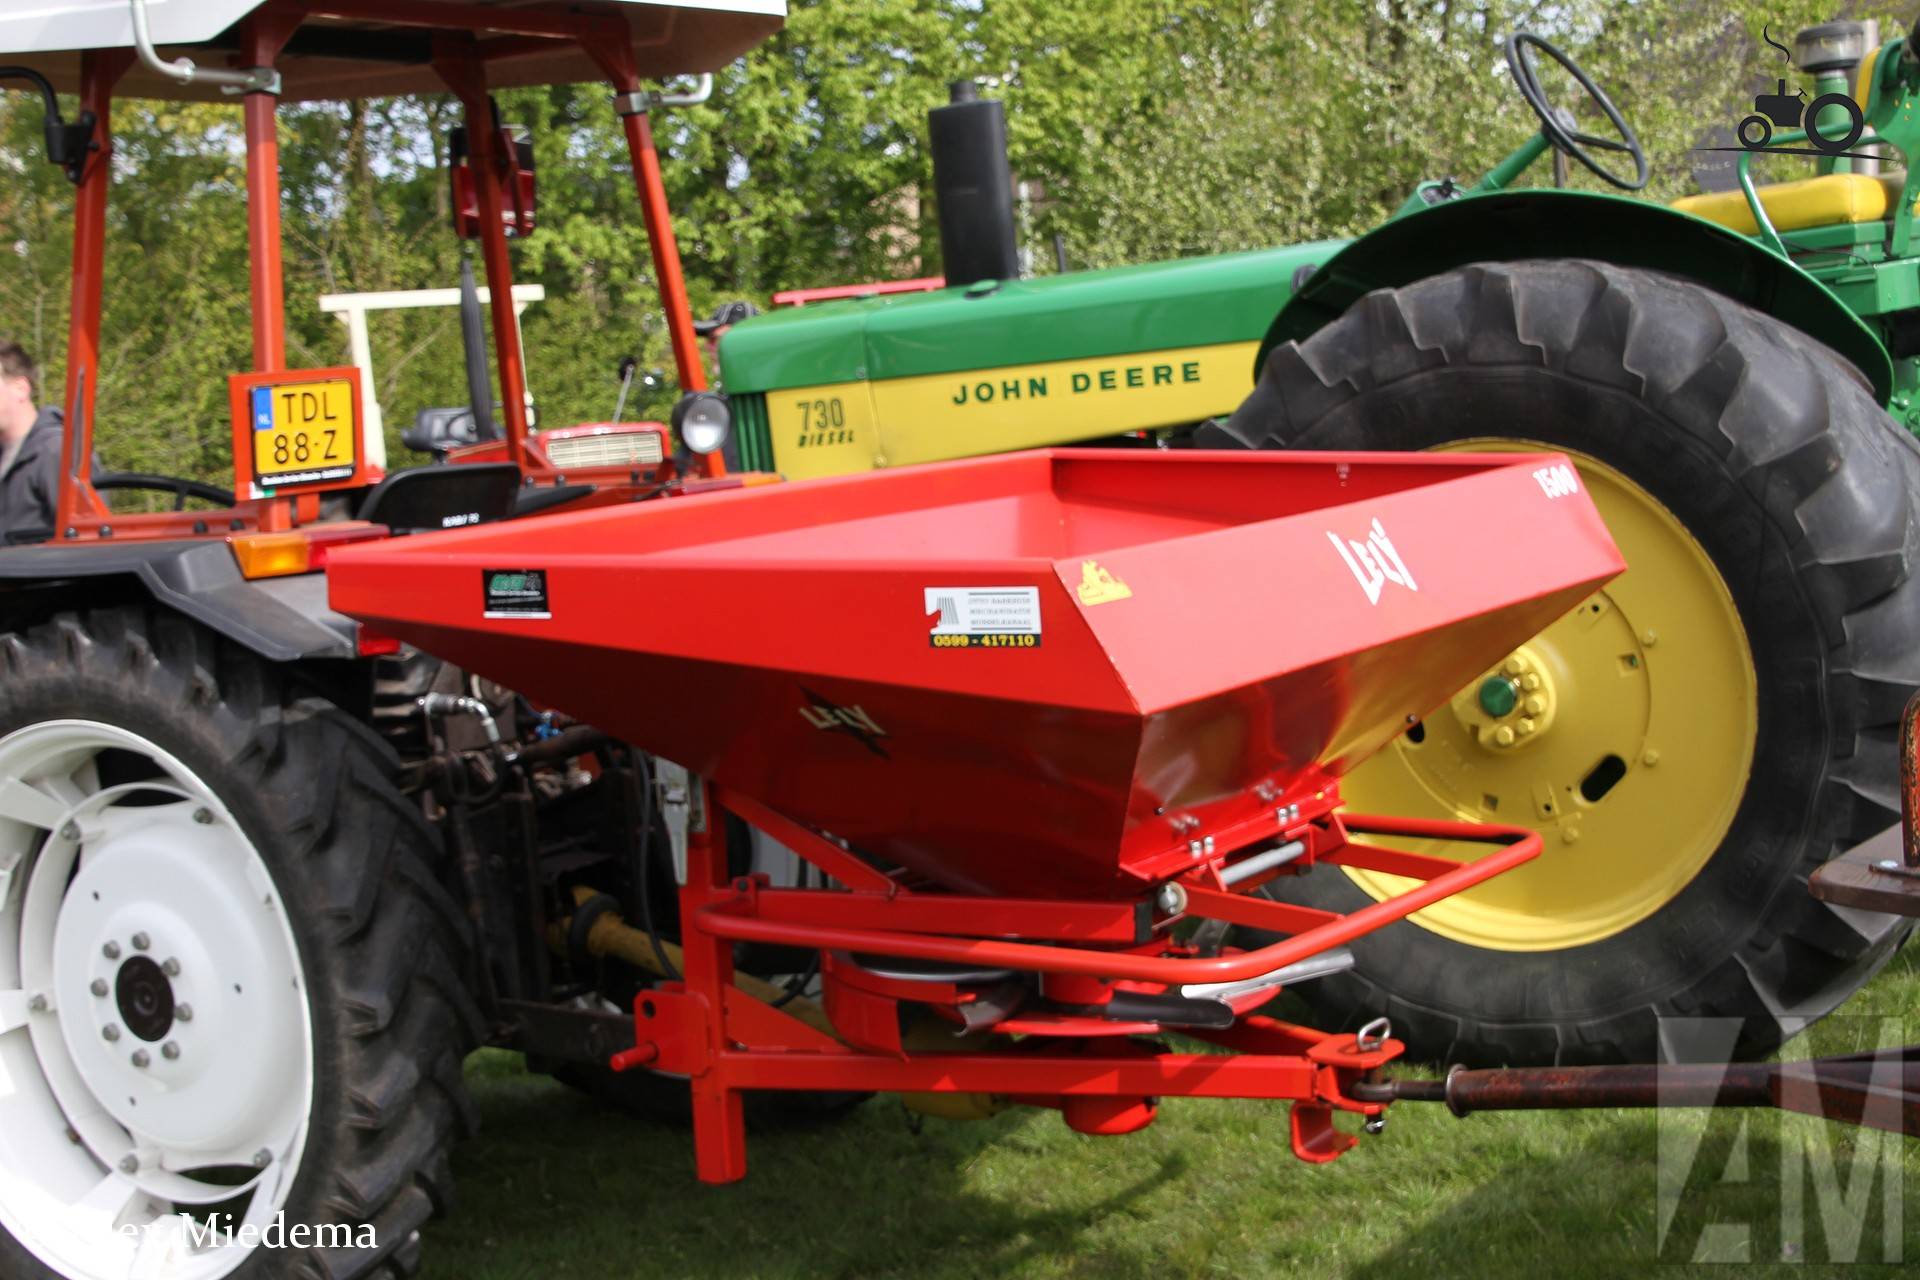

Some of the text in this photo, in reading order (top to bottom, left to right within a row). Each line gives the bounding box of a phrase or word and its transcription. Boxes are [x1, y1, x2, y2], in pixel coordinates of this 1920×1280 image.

[953, 362, 1200, 405] JOHN DEERE
[282, 391, 337, 424] TDL
[796, 398, 844, 432] 730
[798, 430, 854, 448] DIESEL
[1532, 463, 1579, 500] 1500
[1326, 516, 1418, 606] LELY
[933, 634, 969, 647] 0599
[981, 634, 1035, 647] 417110
[799, 704, 886, 735] LELY
